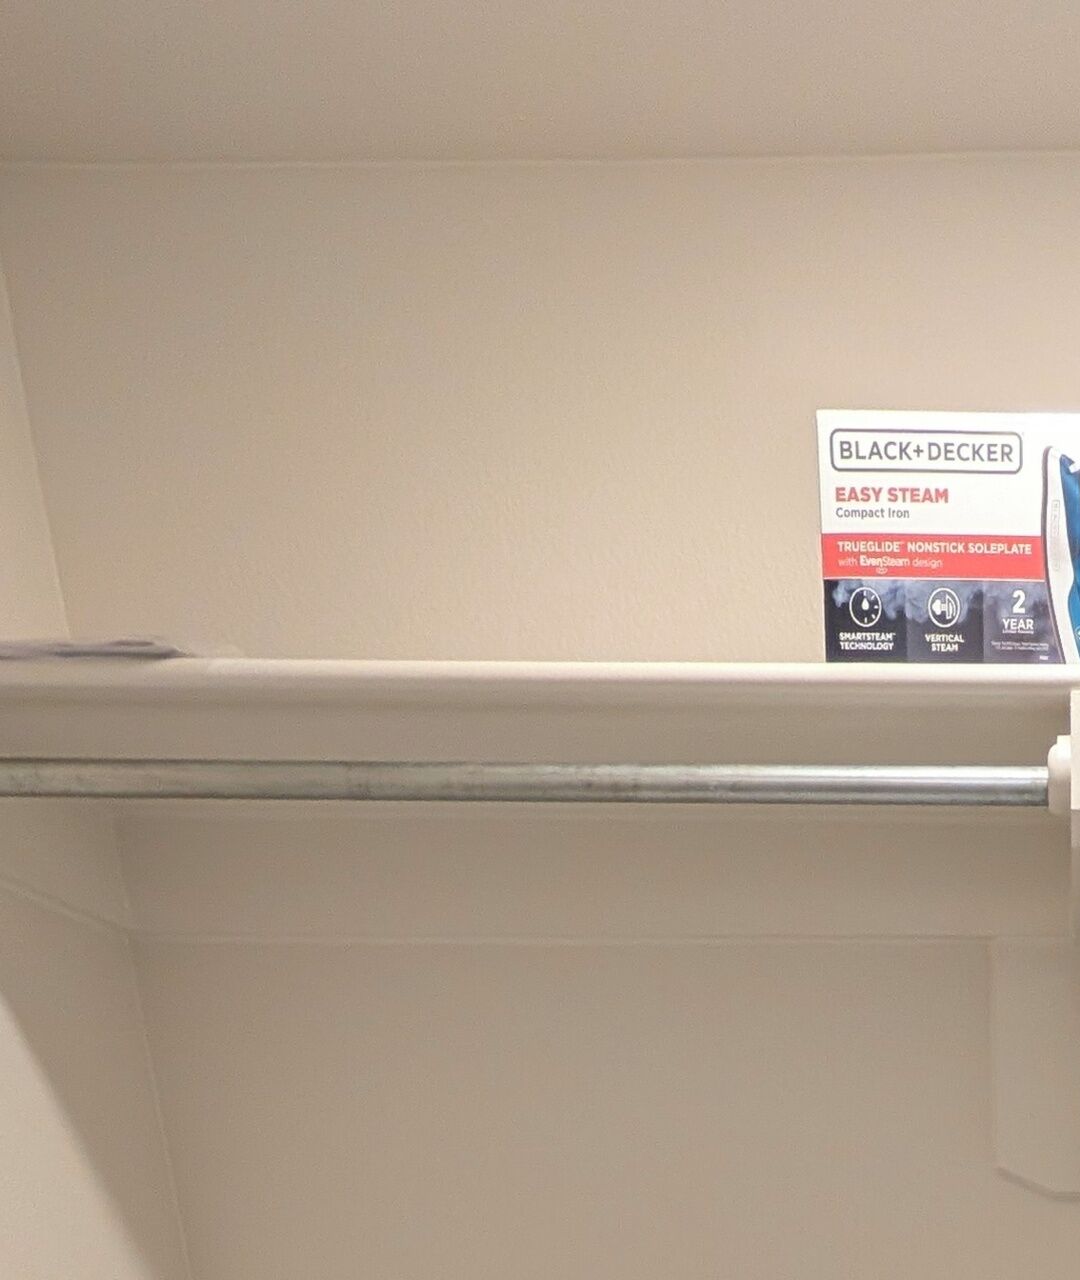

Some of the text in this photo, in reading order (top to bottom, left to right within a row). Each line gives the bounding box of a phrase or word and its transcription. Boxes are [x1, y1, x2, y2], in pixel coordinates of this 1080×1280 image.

[839, 441, 1013, 462] BLACK+DECKER
[835, 487, 949, 503] EASY STEAM
[835, 507, 910, 520] Compact Iron
[907, 542, 964, 553] NONSTICK
[968, 542, 1032, 554] SOLEPLATE
[838, 558, 858, 567] with
[912, 558, 943, 569] design
[1012, 590, 1026, 613] 2
[1002, 619, 1034, 630] YEAR
[925, 634, 965, 643] VERTICAL
[839, 641, 894, 650] TECHNOLOGY
[931, 643, 959, 652] STEAM
